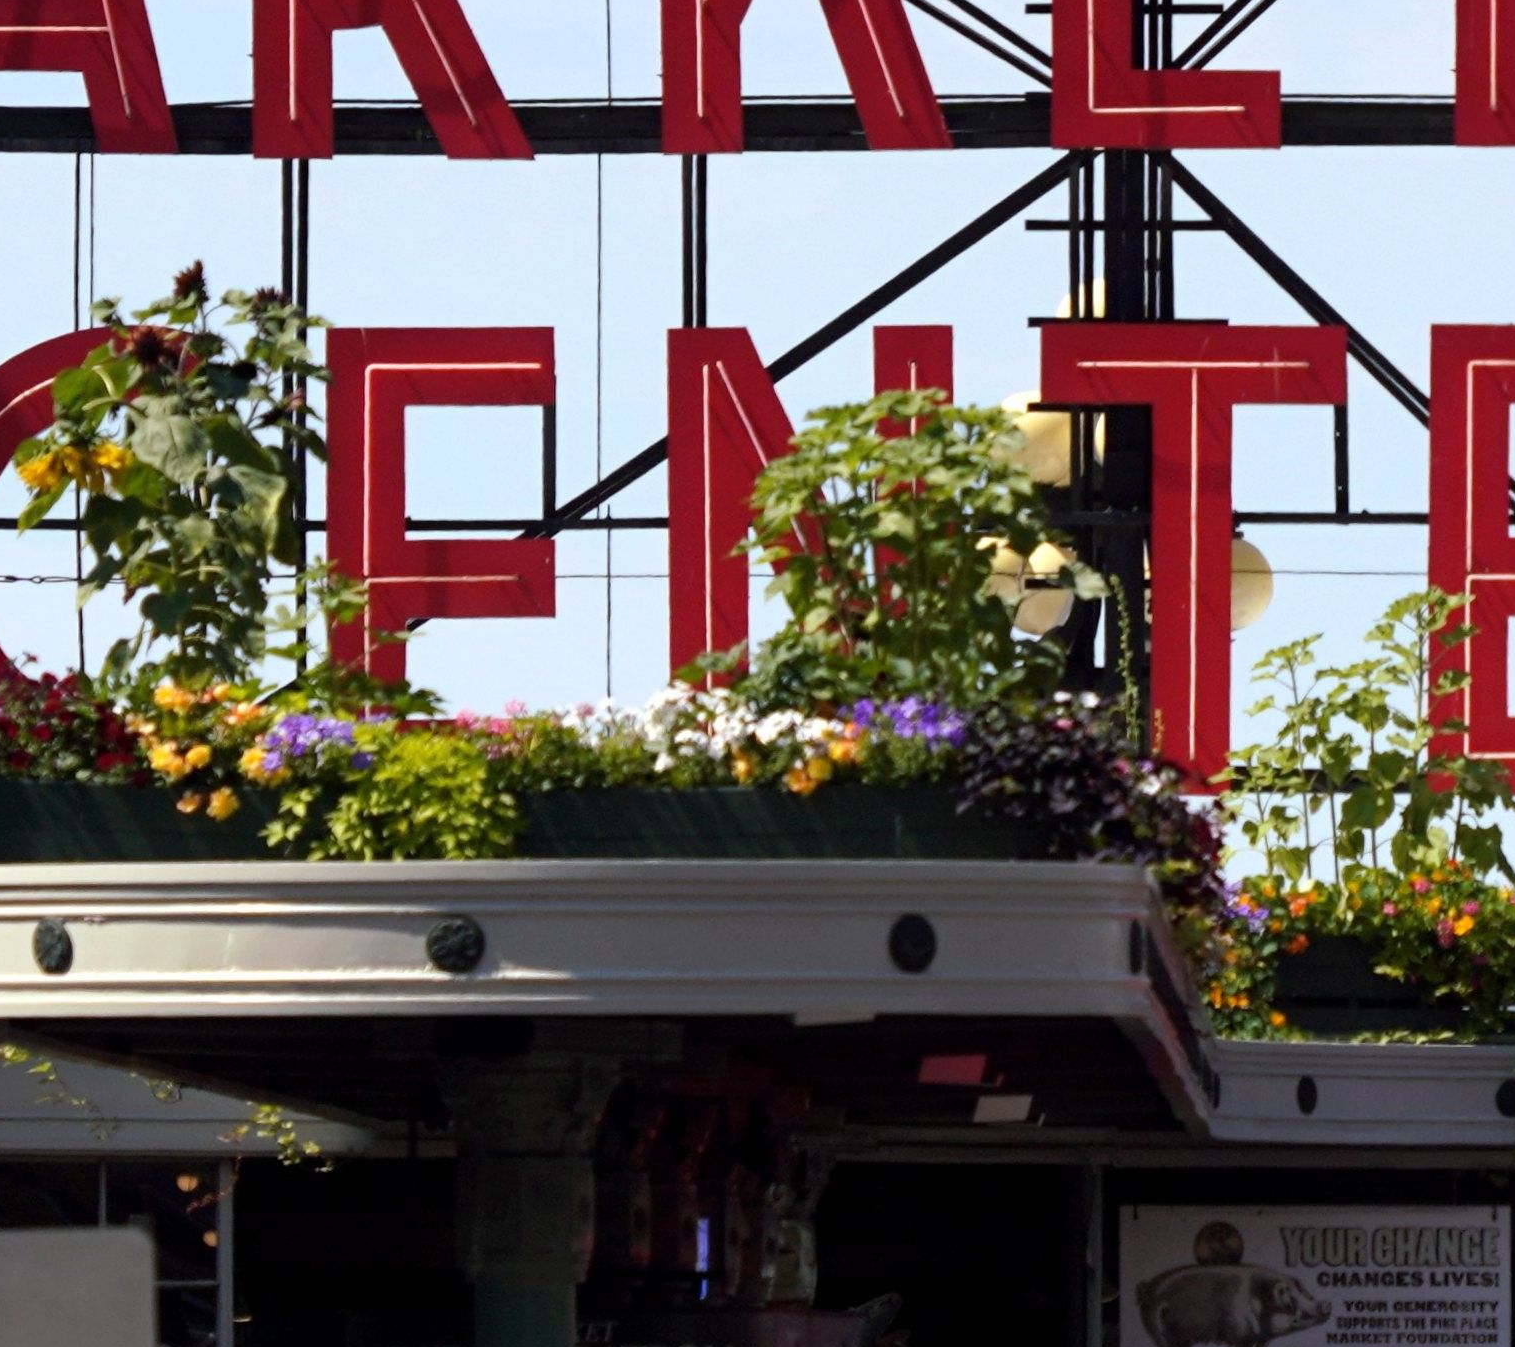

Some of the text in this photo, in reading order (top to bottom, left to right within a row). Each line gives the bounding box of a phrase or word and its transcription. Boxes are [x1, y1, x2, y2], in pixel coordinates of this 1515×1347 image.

[1280, 1226, 1501, 1268] YOUR CHANGE
[1317, 1271, 1500, 1289] CHANGES LIVES!
[1344, 1300, 1499, 1313] YOUR GENEROSITY
[1337, 1316, 1499, 1330] SUPPORTS THE PIKE PLACE
[1326, 1332, 1499, 1344] MARKET FOUNDATION
